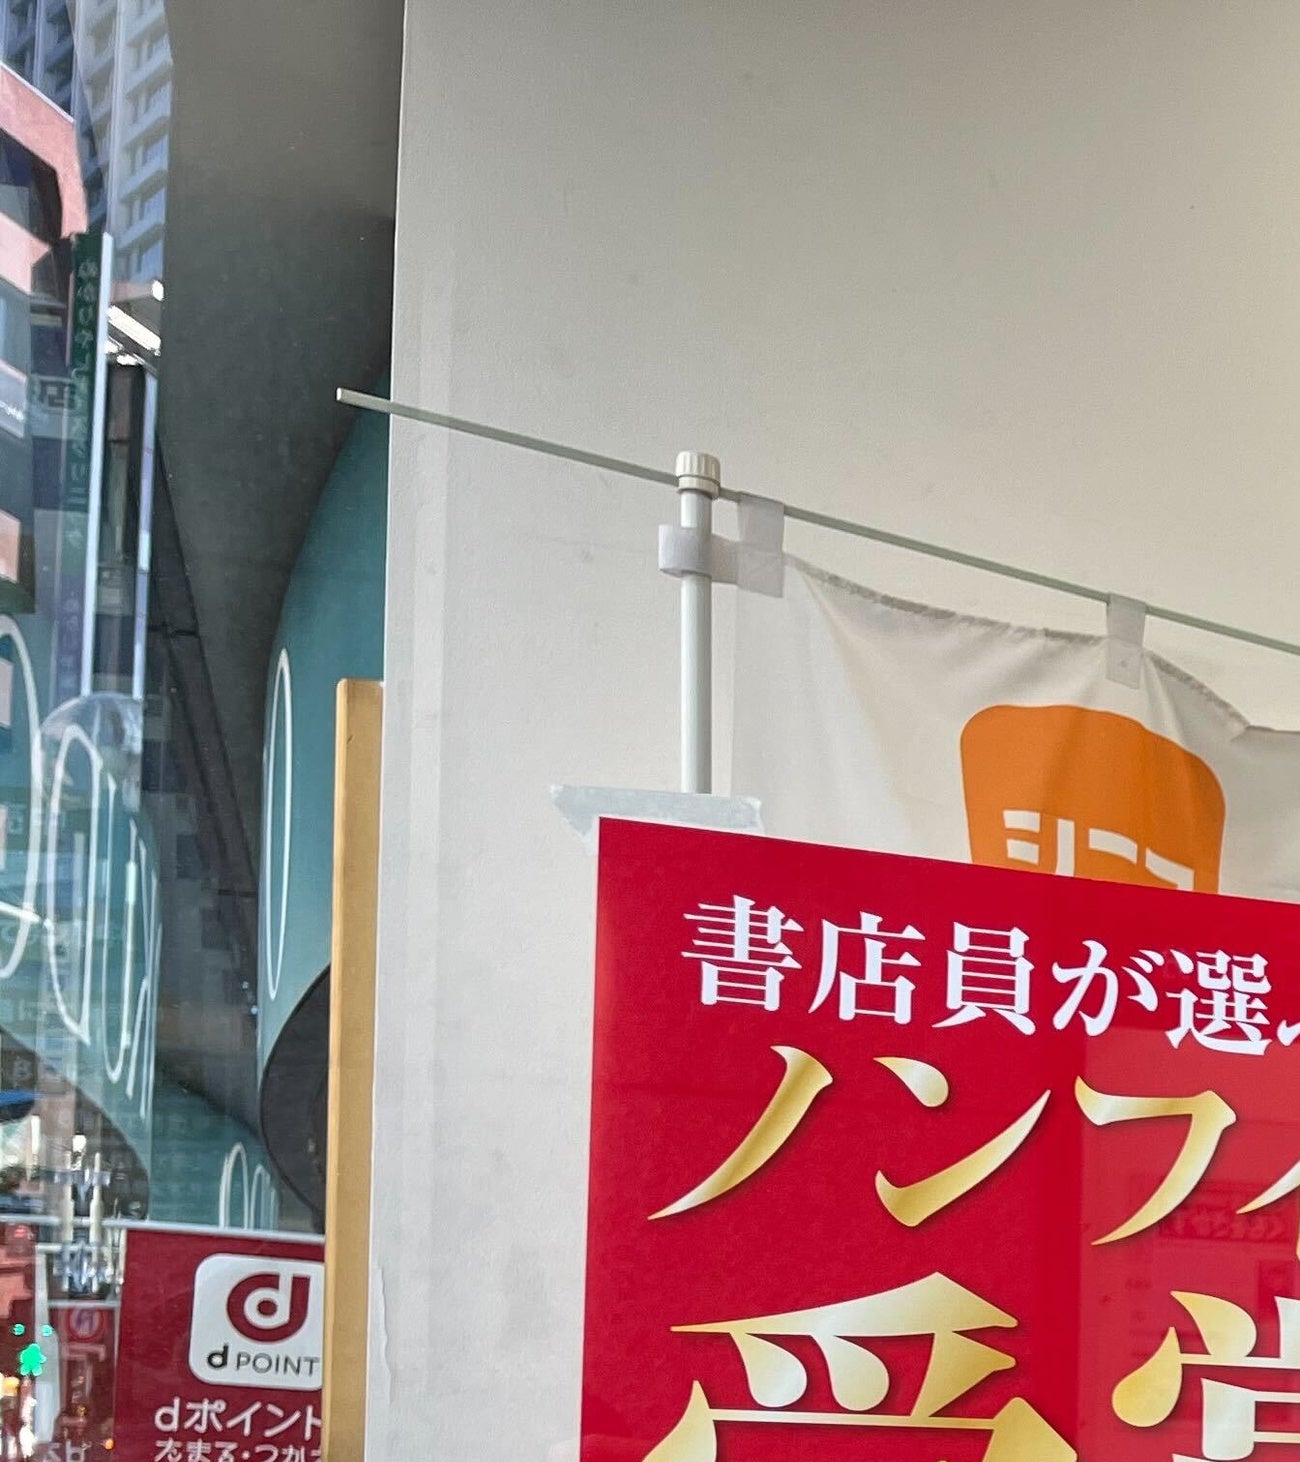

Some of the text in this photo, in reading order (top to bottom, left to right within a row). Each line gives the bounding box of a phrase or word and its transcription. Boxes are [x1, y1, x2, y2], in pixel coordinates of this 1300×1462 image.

[236, 1352, 320, 1378] POINT
[154, 1397, 323, 1441] dポイント
